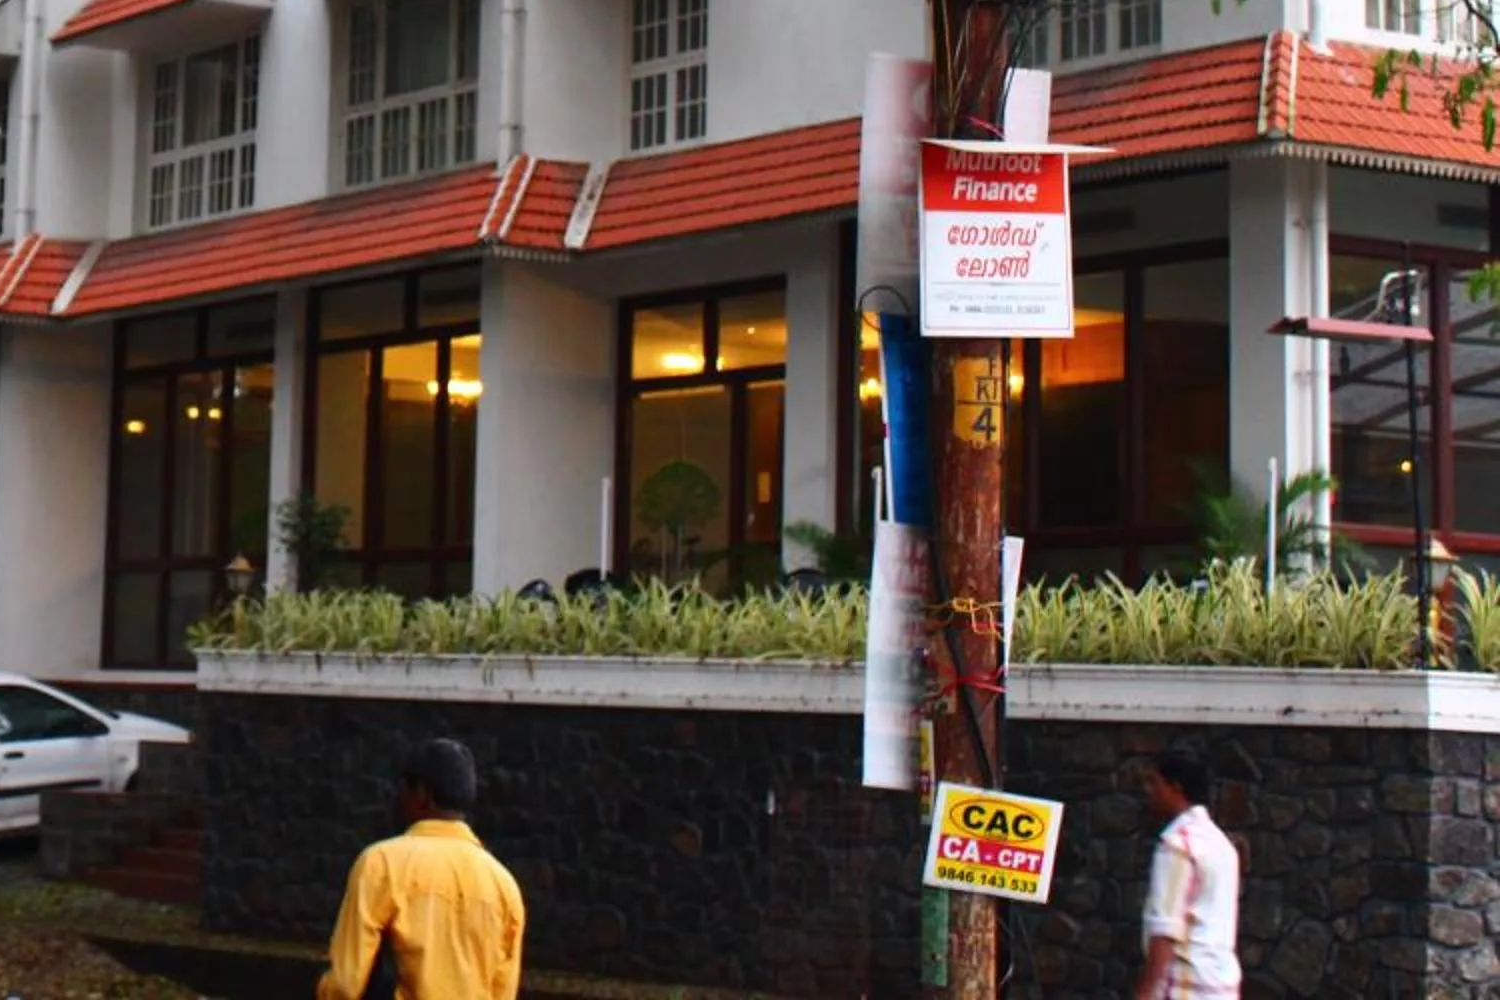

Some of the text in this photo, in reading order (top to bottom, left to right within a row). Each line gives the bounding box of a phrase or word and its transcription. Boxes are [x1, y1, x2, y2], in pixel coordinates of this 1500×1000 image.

[946, 150, 1042, 173] Muthoot
[952, 176, 1038, 202] Finance
[972, 407, 996, 440] 4
[963, 805, 1035, 838] CAC
[943, 837, 980, 862] CA
[998, 849, 1040, 871] CPT
[937, 866, 1037, 893] 9846 143 533
